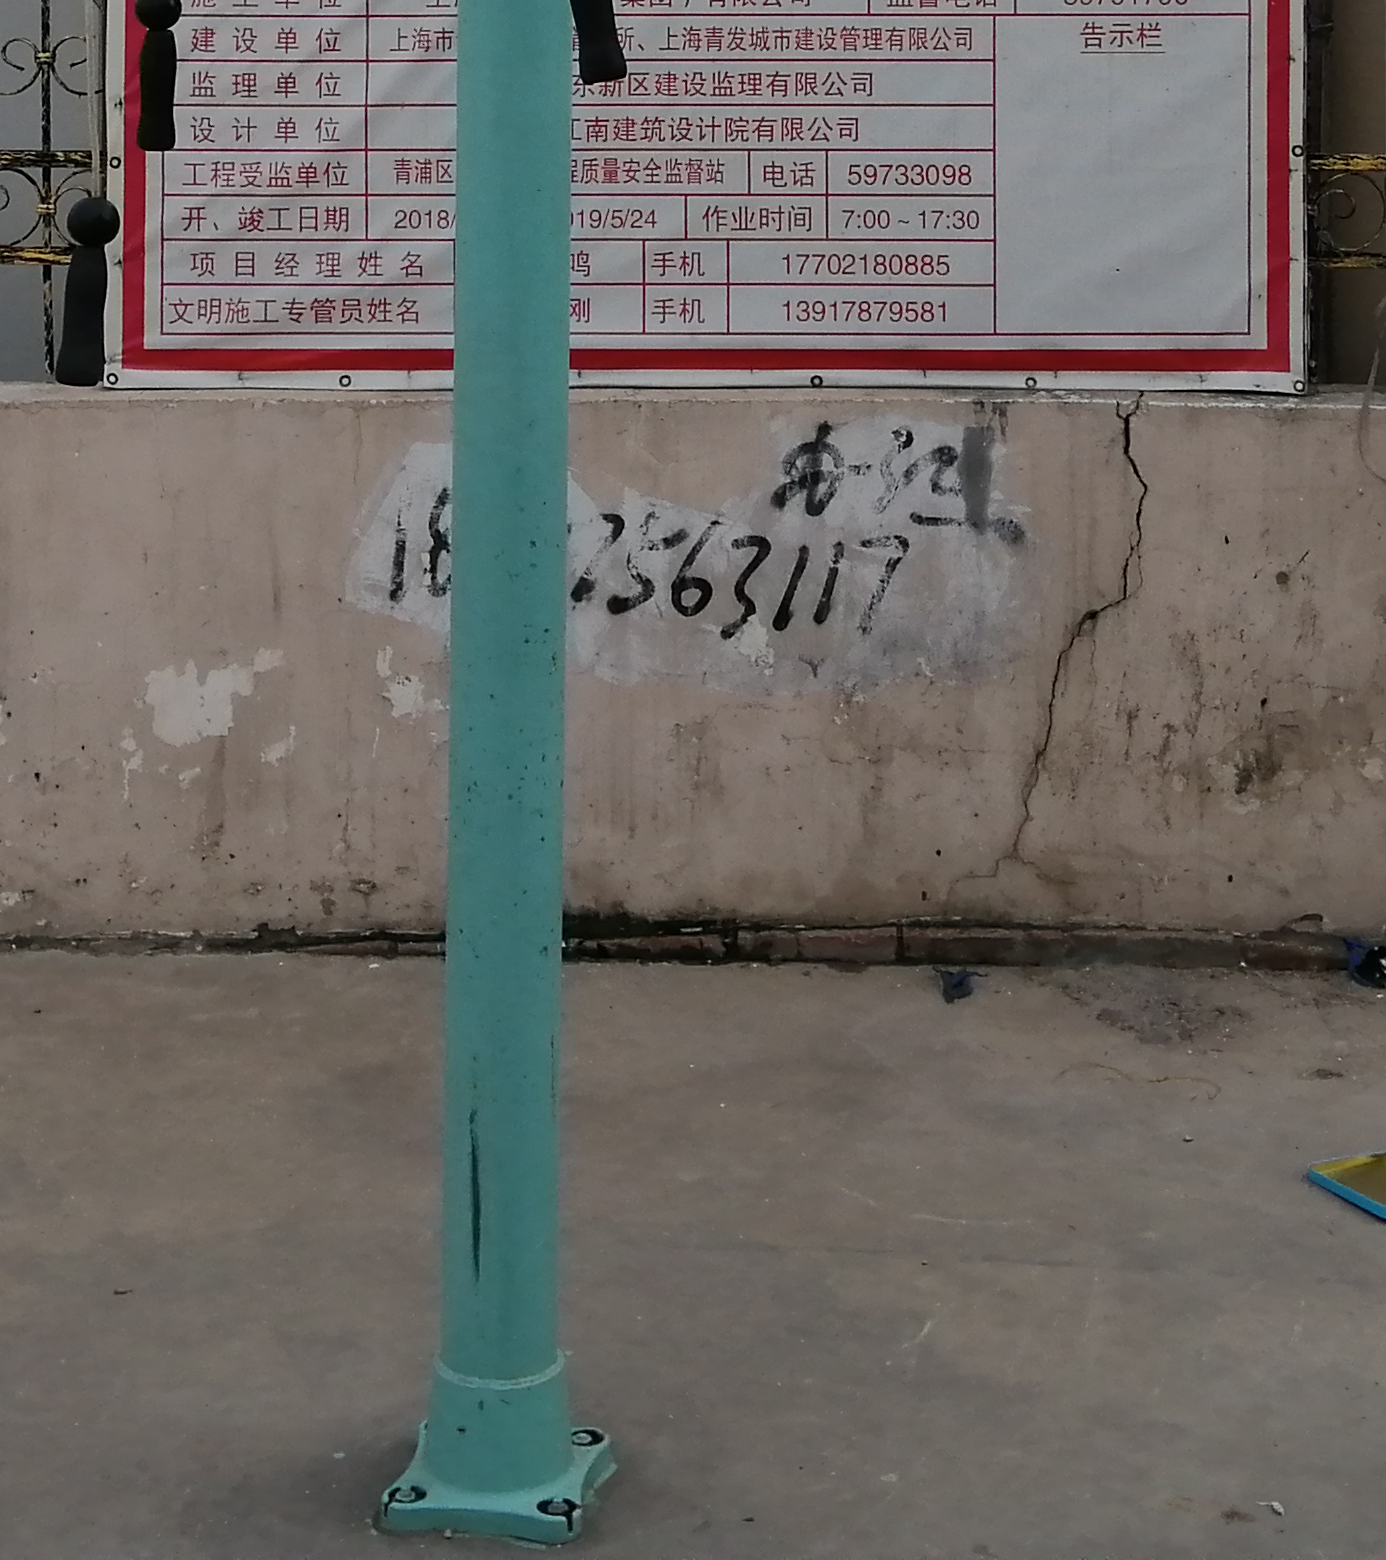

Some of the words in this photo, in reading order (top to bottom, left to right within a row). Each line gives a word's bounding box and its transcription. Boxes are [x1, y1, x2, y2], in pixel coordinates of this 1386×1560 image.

[191, 26, 341, 54] 建设单位
[1080, 22, 1162, 48] 告示栏
[189, 71, 341, 98] 监理单位
[190, 117, 340, 143] 设计单位
[182, 161, 349, 188] 工程受监单位
[393, 158, 453, 184] 青浦区
[763, 161, 816, 187] 电话
[848, 164, 971, 185] 59733098
[702, 205, 811, 232] 作业时间
[190, 251, 423, 278] 项目经理姓名
[651, 251, 705, 277] 手机
[782, 254, 949, 275] 17702180885
[169, 297, 418, 324] 文明施工专管员姓名
[652, 297, 705, 323] 手机
[782, 300, 946, 322] 13917879581
